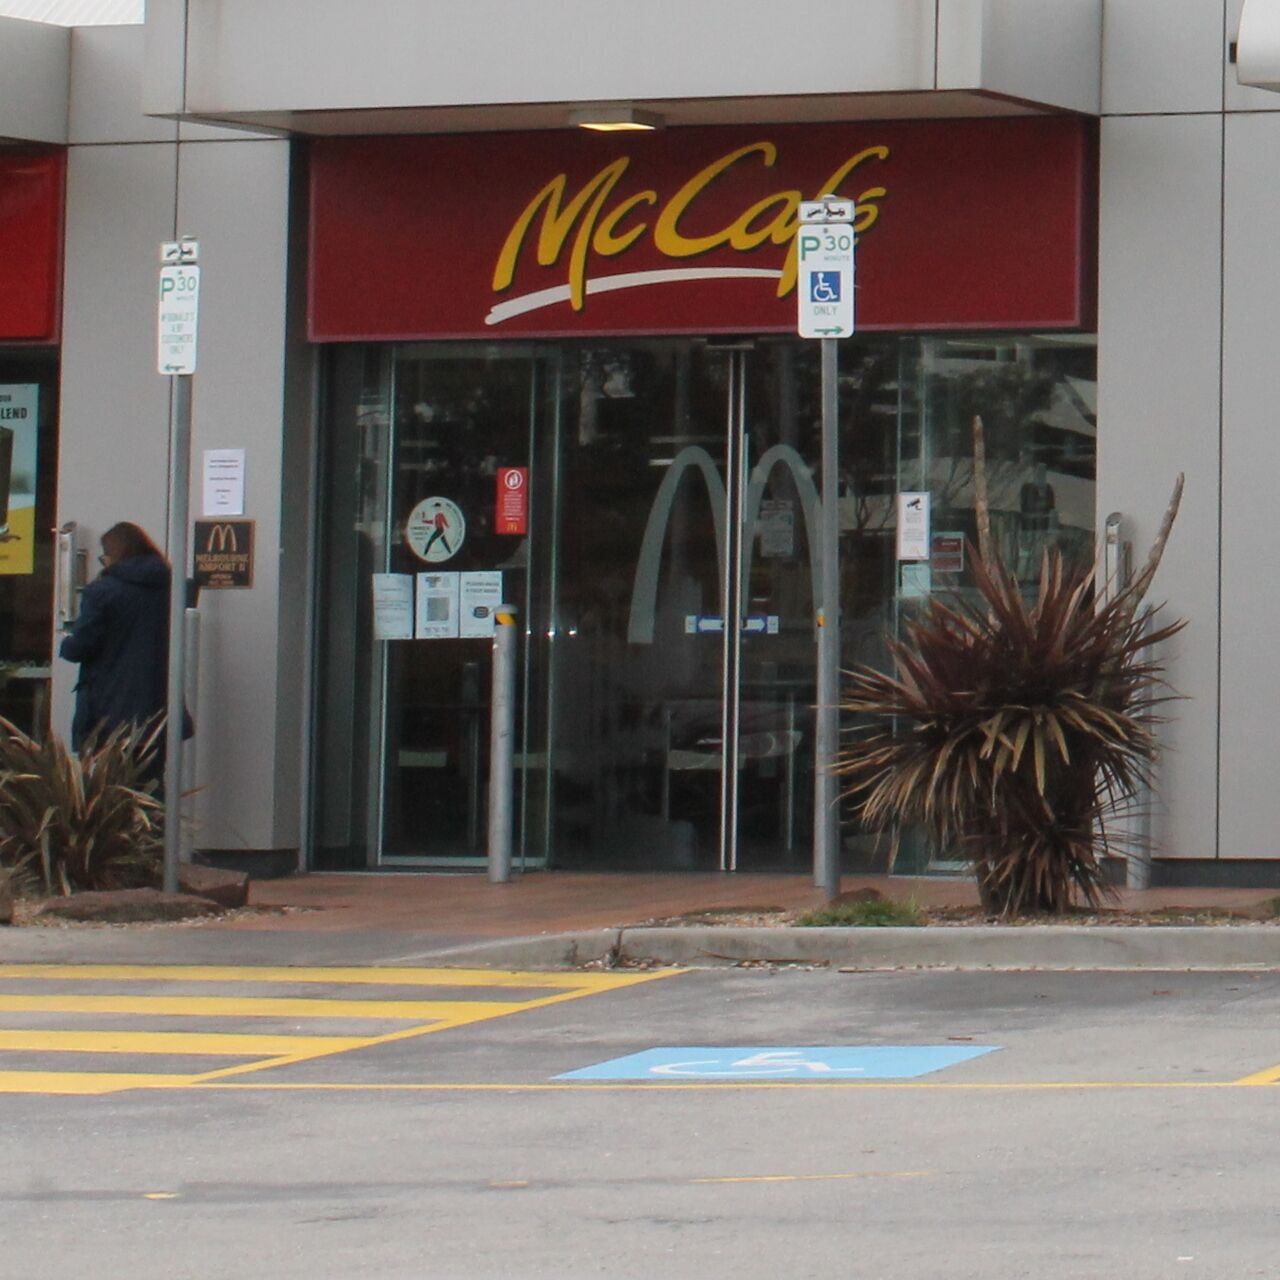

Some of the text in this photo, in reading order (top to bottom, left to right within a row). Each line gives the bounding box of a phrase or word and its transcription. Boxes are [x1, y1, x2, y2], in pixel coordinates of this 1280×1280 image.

[801, 235, 850, 261] P 30
[160, 276, 196, 302] P 30
